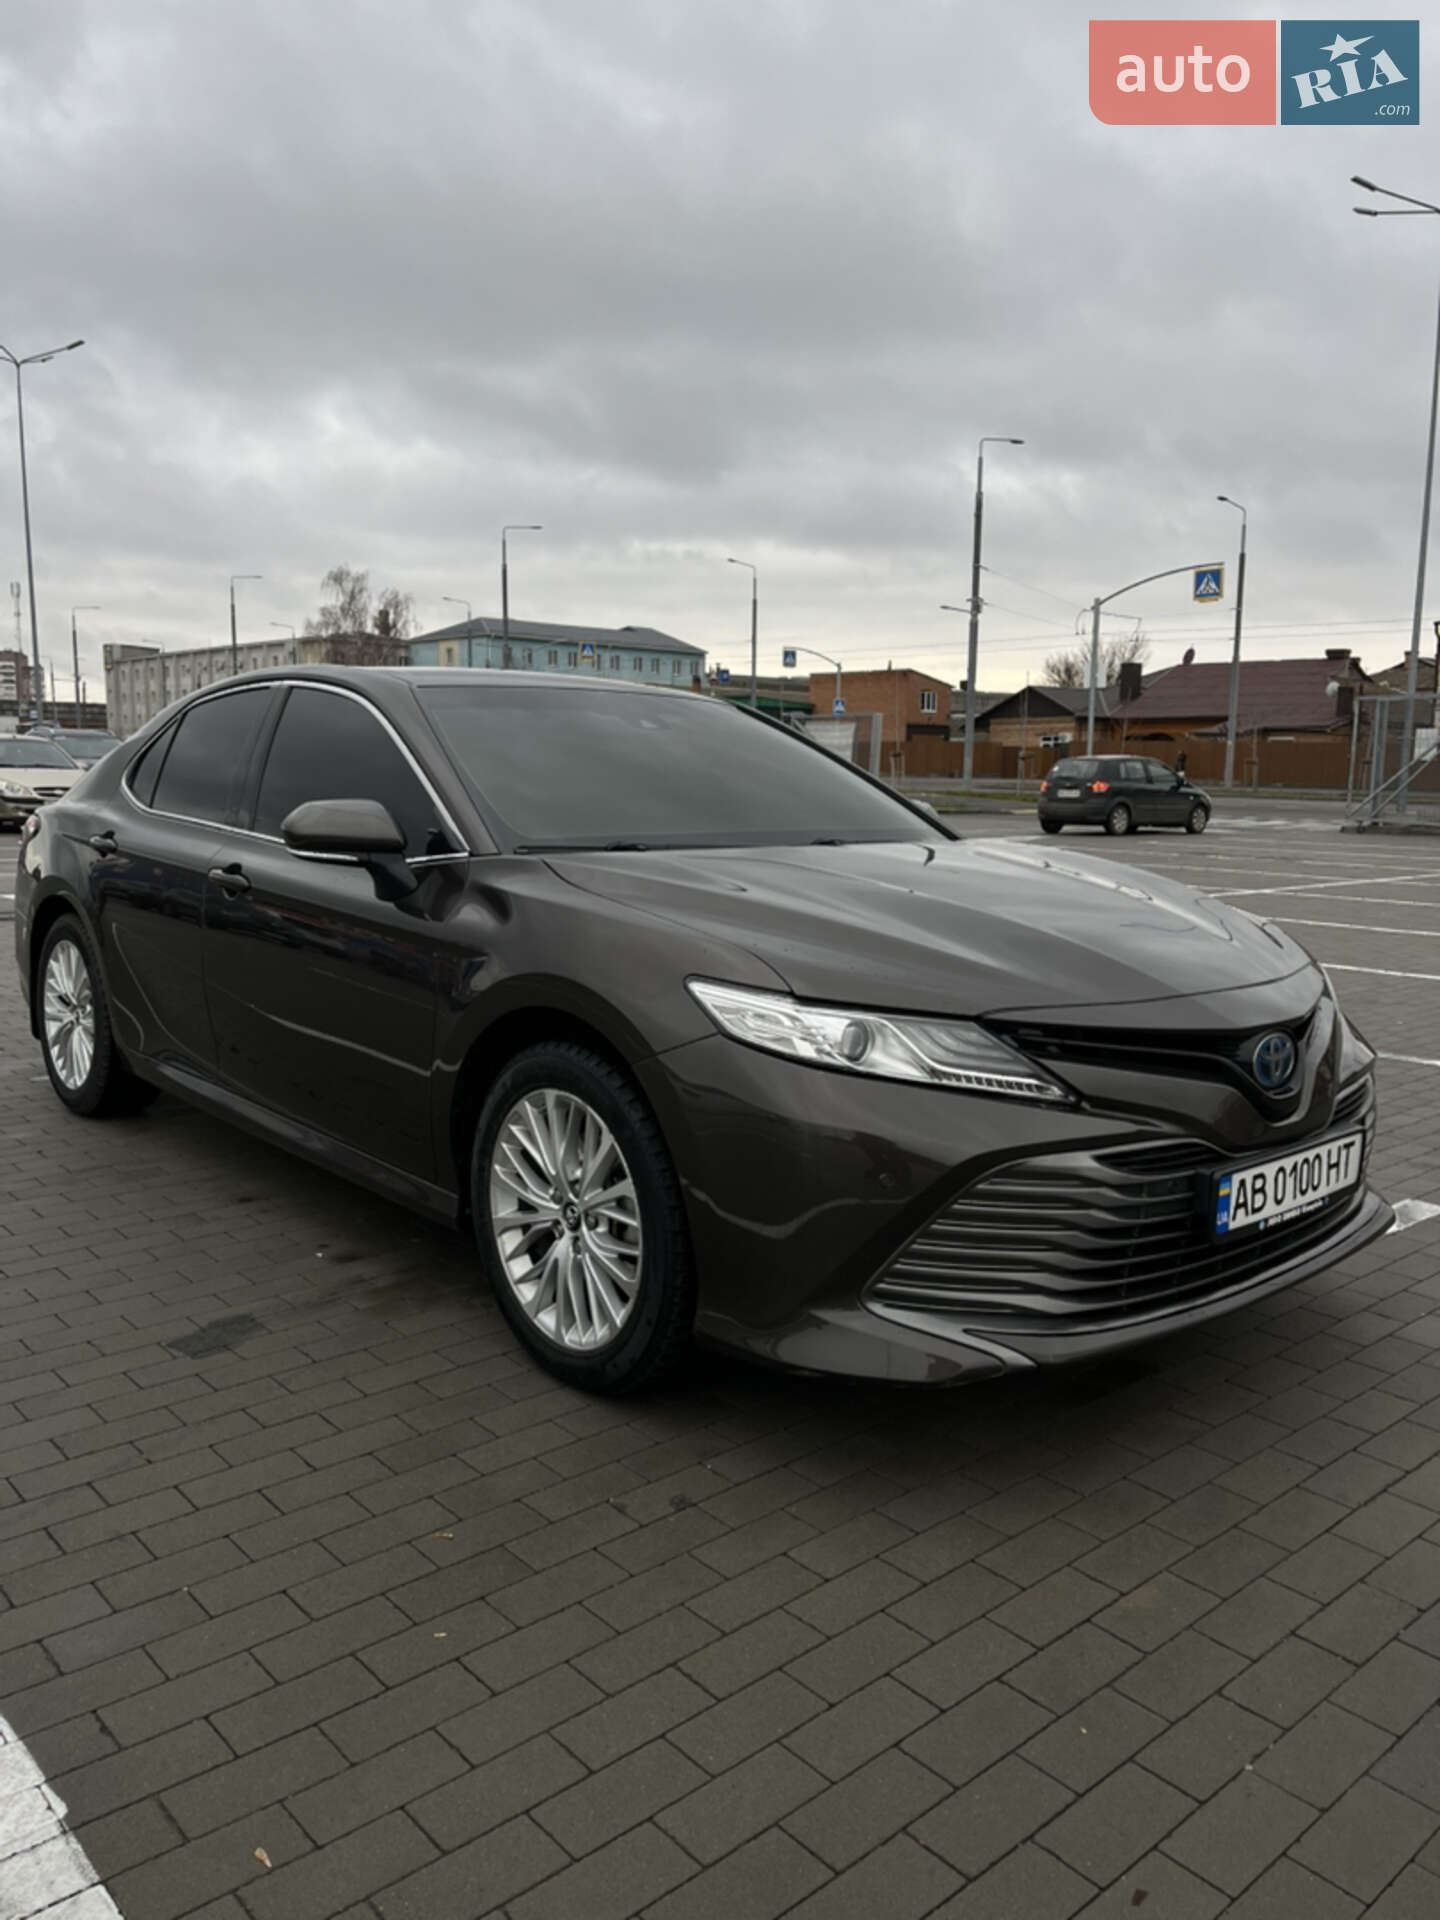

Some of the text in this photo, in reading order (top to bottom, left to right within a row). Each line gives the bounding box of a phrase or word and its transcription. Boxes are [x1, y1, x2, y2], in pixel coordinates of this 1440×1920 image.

[1231, 1172, 1268, 1222] AB
[1273, 1153, 1323, 1206] 0100
[1326, 1141, 1356, 1187] HT
